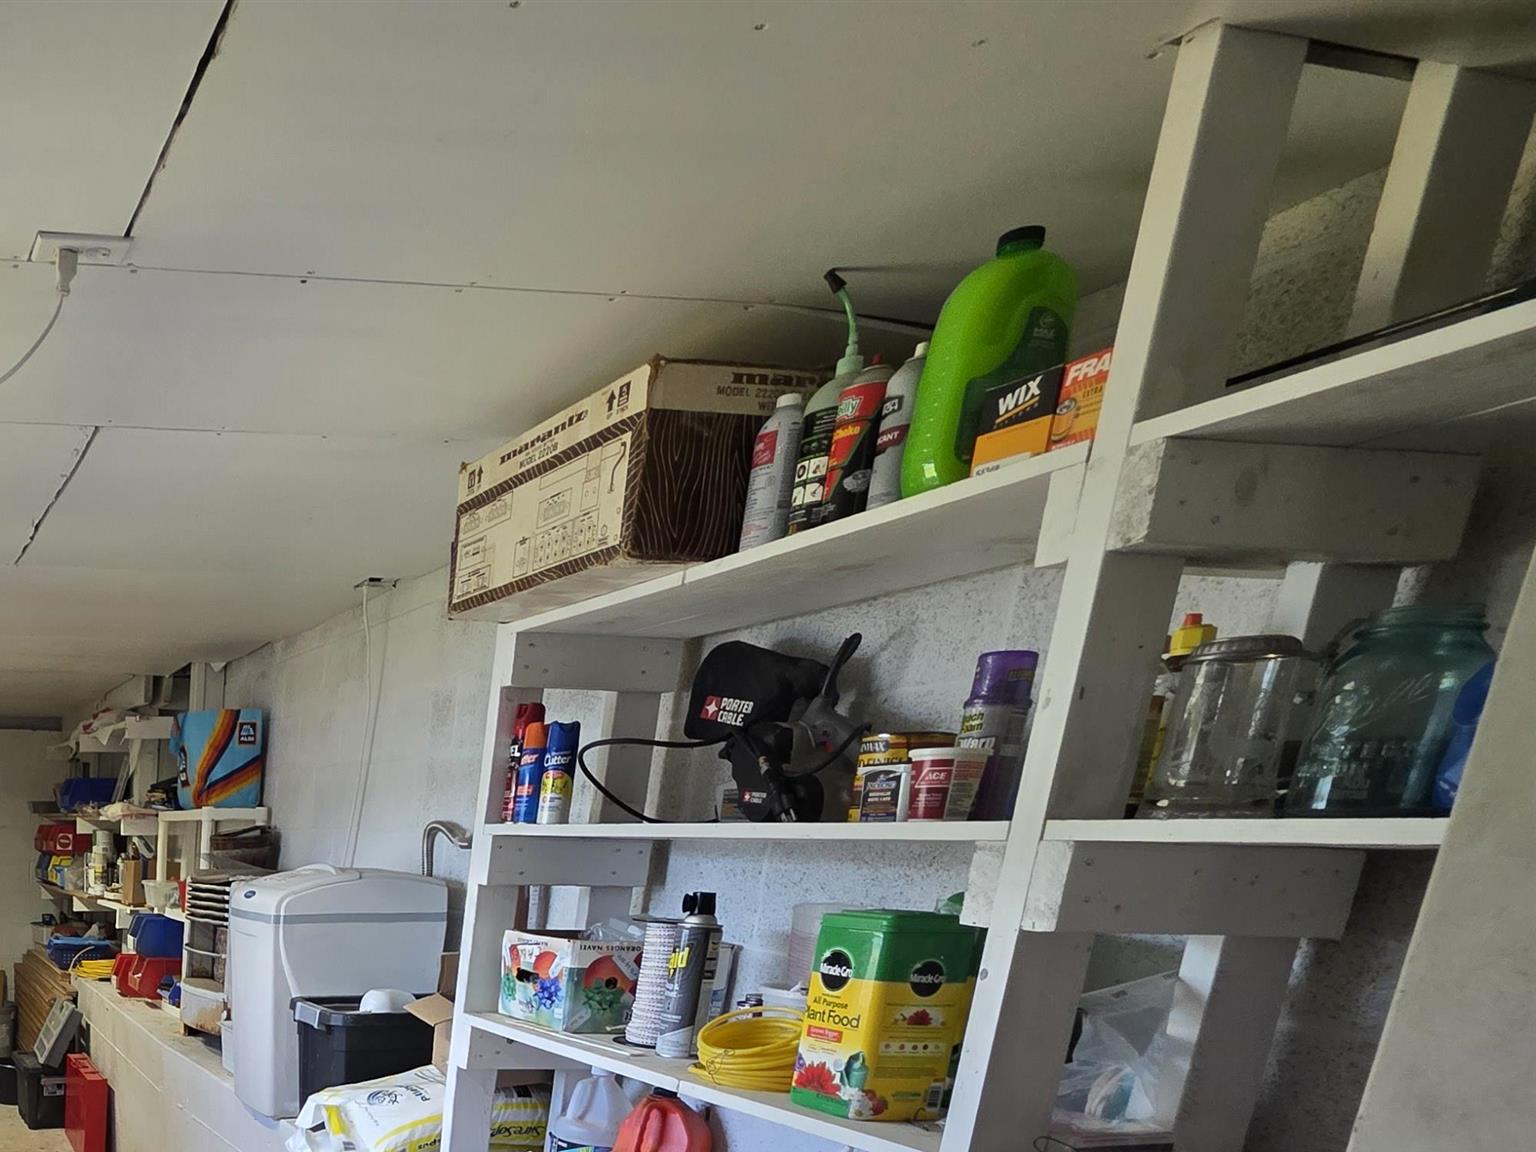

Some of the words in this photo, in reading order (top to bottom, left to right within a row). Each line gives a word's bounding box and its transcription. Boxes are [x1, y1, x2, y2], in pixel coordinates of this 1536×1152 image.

[1066, 352, 1112, 387] FRA
[716, 385, 751, 398] MODEL
[998, 374, 1044, 417] WIX
[499, 409, 589, 466] marantz
[720, 697, 754, 714] PORTER
[717, 710, 744, 727] CABLE
[543, 753, 572, 767] Cutter
[925, 771, 948, 781] ACE
[607, 944, 642, 953] ORANGES
[668, 946, 690, 969] aid
[819, 962, 854, 979] Miracle-Gro
[813, 995, 821, 1005] All
[821, 999, 849, 1011] Purpose
[827, 1010, 862, 1030] Food
